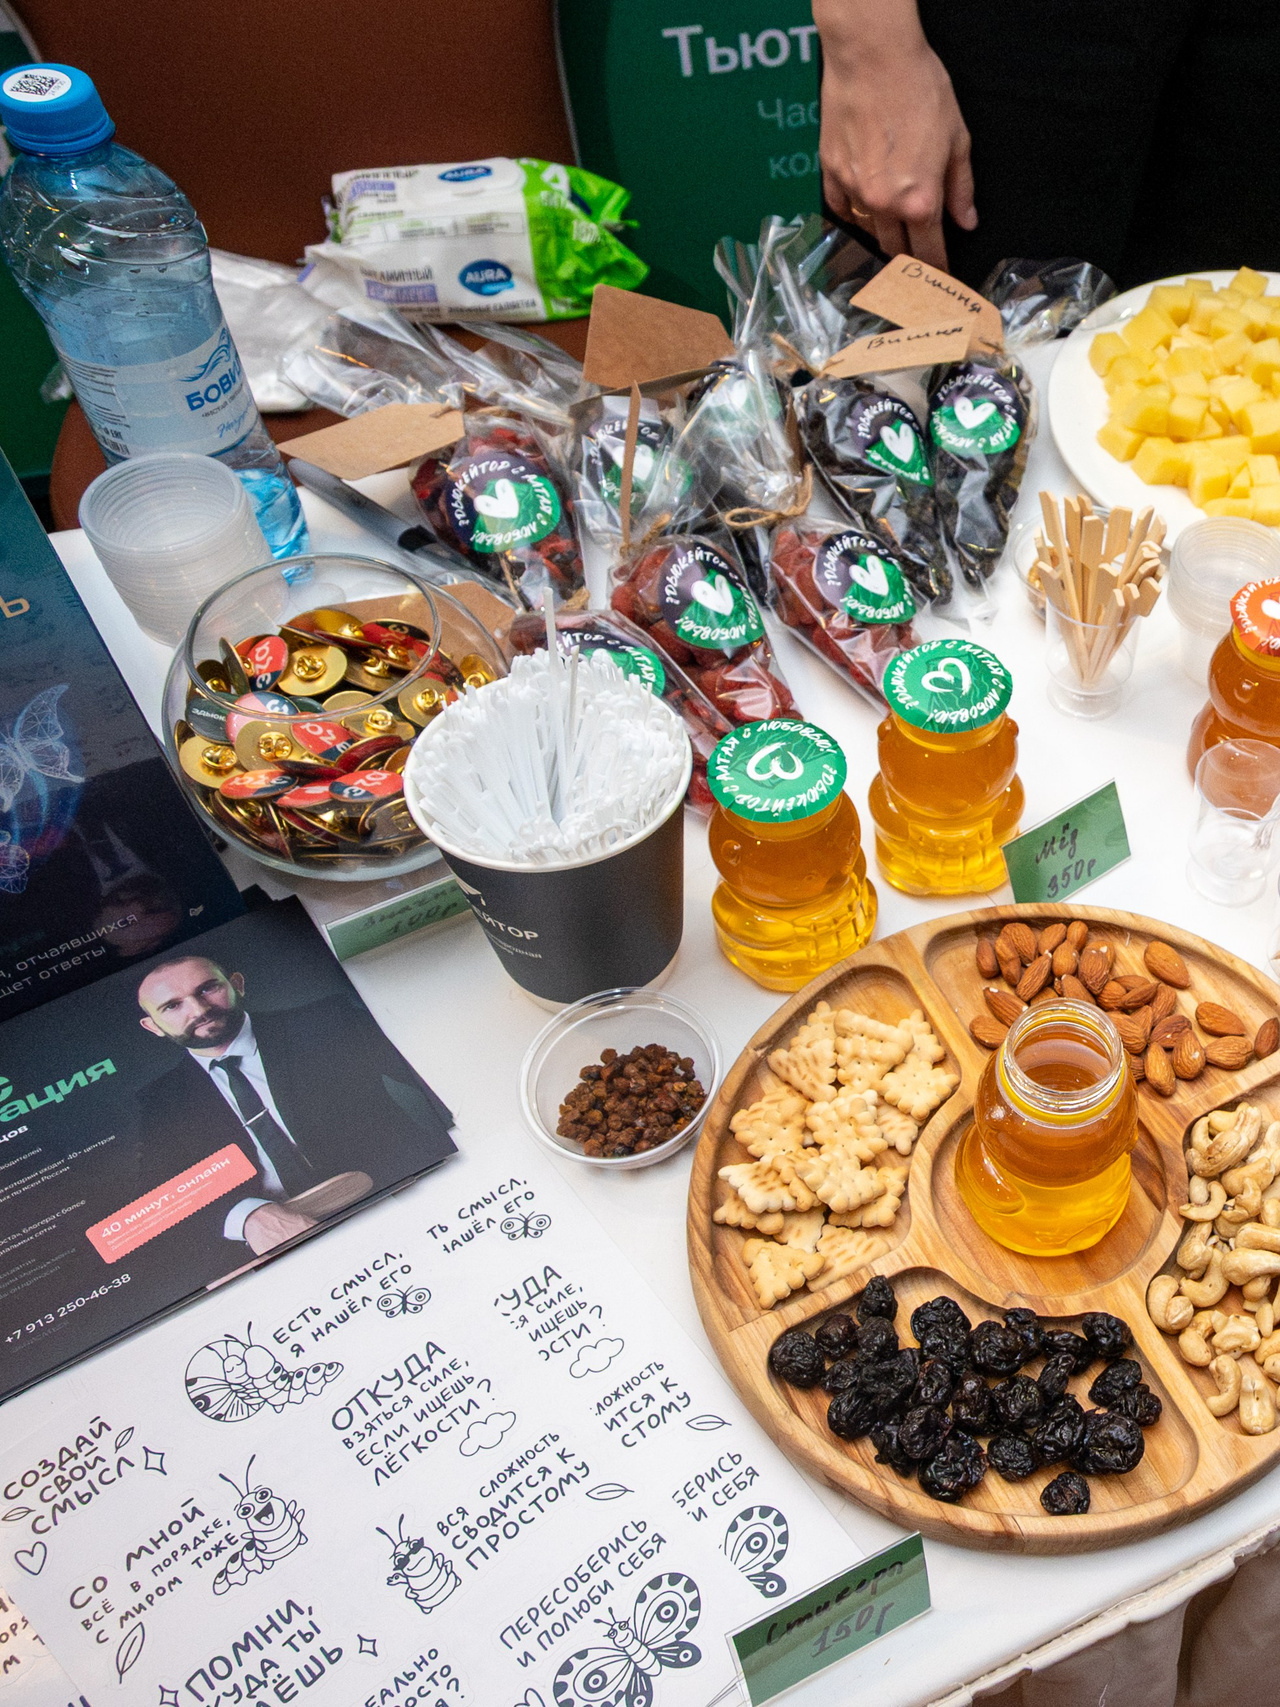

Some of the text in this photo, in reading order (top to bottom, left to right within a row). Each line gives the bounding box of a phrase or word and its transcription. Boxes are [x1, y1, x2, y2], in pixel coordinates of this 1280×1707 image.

[465, 269, 507, 283] AURA
[901, 261, 983, 313] Вишня
[1035, 822, 1079, 864] Мёд
[1047, 859, 1096, 898] 350р
[16, 913, 138, 971] отчаявшихся
[38, 946, 106, 980] ответы
[101, 1221, 122, 1239] 40
[124, 1194, 175, 1225] минут,
[177, 1158, 230, 1193] онлайн
[457, 1177, 528, 1221] СМЫСЛ,
[503, 1190, 536, 1215] ЕГО
[4, 1329, 22, 1343] +7
[26, 1313, 55, 1333] 913
[57, 1273, 131, 1317] 250-46-38
[273, 1251, 404, 1345] ЕСТЬ СМЫСЛ,
[290, 1262, 412, 1358] Я НАШЁЛ ЕГО
[528, 1299, 588, 1343] ИЩЕШЬ
[535, 1283, 585, 1315] СИЛЕ,
[331, 1341, 446, 1431] ОТКУДА
[342, 1359, 470, 1450] ВЗЯТЬСЯ СИЛЕ,
[356, 1373, 476, 1467] ЕСЛИ ИЩЕШЬ
[589, 1361, 665, 1416] ЛОЖНОСТЬ
[2, 1414, 112, 1501] СОЗДАЙ
[38, 1446, 106, 1504] СВОЙ
[373, 1398, 480, 1487] ЛЁГКОСТИ
[31, 1456, 135, 1535] СМЫСЛ
[436, 1431, 560, 1537] ВСЯ СЛОЖНОСТЬ
[451, 1447, 576, 1551] СВОДИТСЯ К
[465, 1461, 591, 1571] ПРОСТОМУ
[712, 1466, 760, 1506] СЕБЯ
[69, 1497, 206, 1610] СО МНОЙ
[81, 1517, 232, 1631] ВСЁ В ПОРЯДКЕ,
[95, 1532, 241, 1646] С МИРОМ ТОЖЕ
[499, 1518, 648, 1650] ПЕРЕСОБЕРИСЬ
[281, 1620, 321, 1653] ТЫ
[516, 1532, 667, 1669] И ПОЛЮБИ СЕБЯ
[185, 1599, 313, 1703] ПОМНИ,
